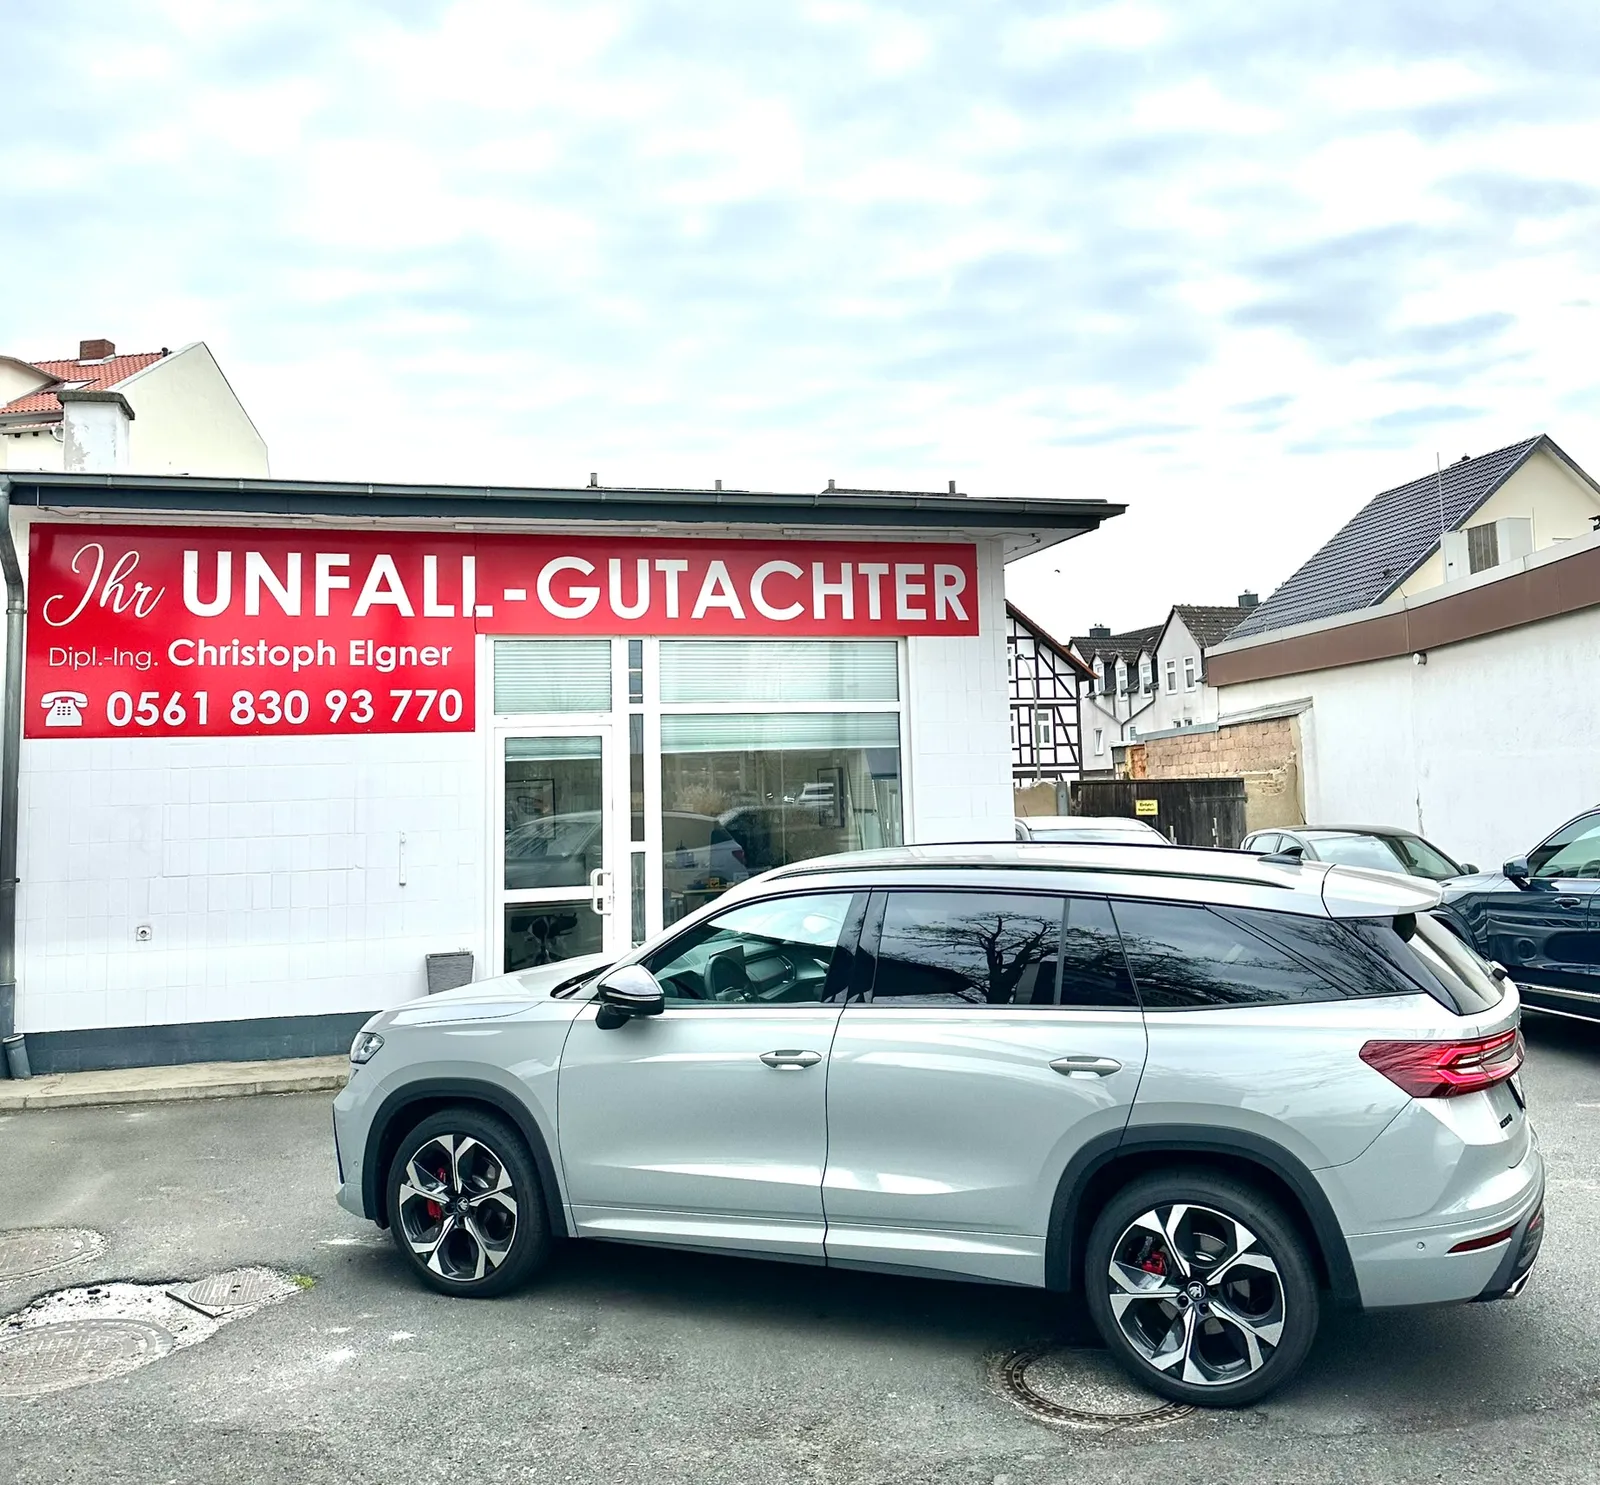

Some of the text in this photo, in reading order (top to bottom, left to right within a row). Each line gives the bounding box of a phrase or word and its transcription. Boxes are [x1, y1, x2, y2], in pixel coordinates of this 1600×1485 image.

[42, 542, 166, 627] Ihr
[48, 638, 453, 673] Dipl.-Ing. Christoph Elgner
[106, 688, 463, 727] 0561 830 93 770
